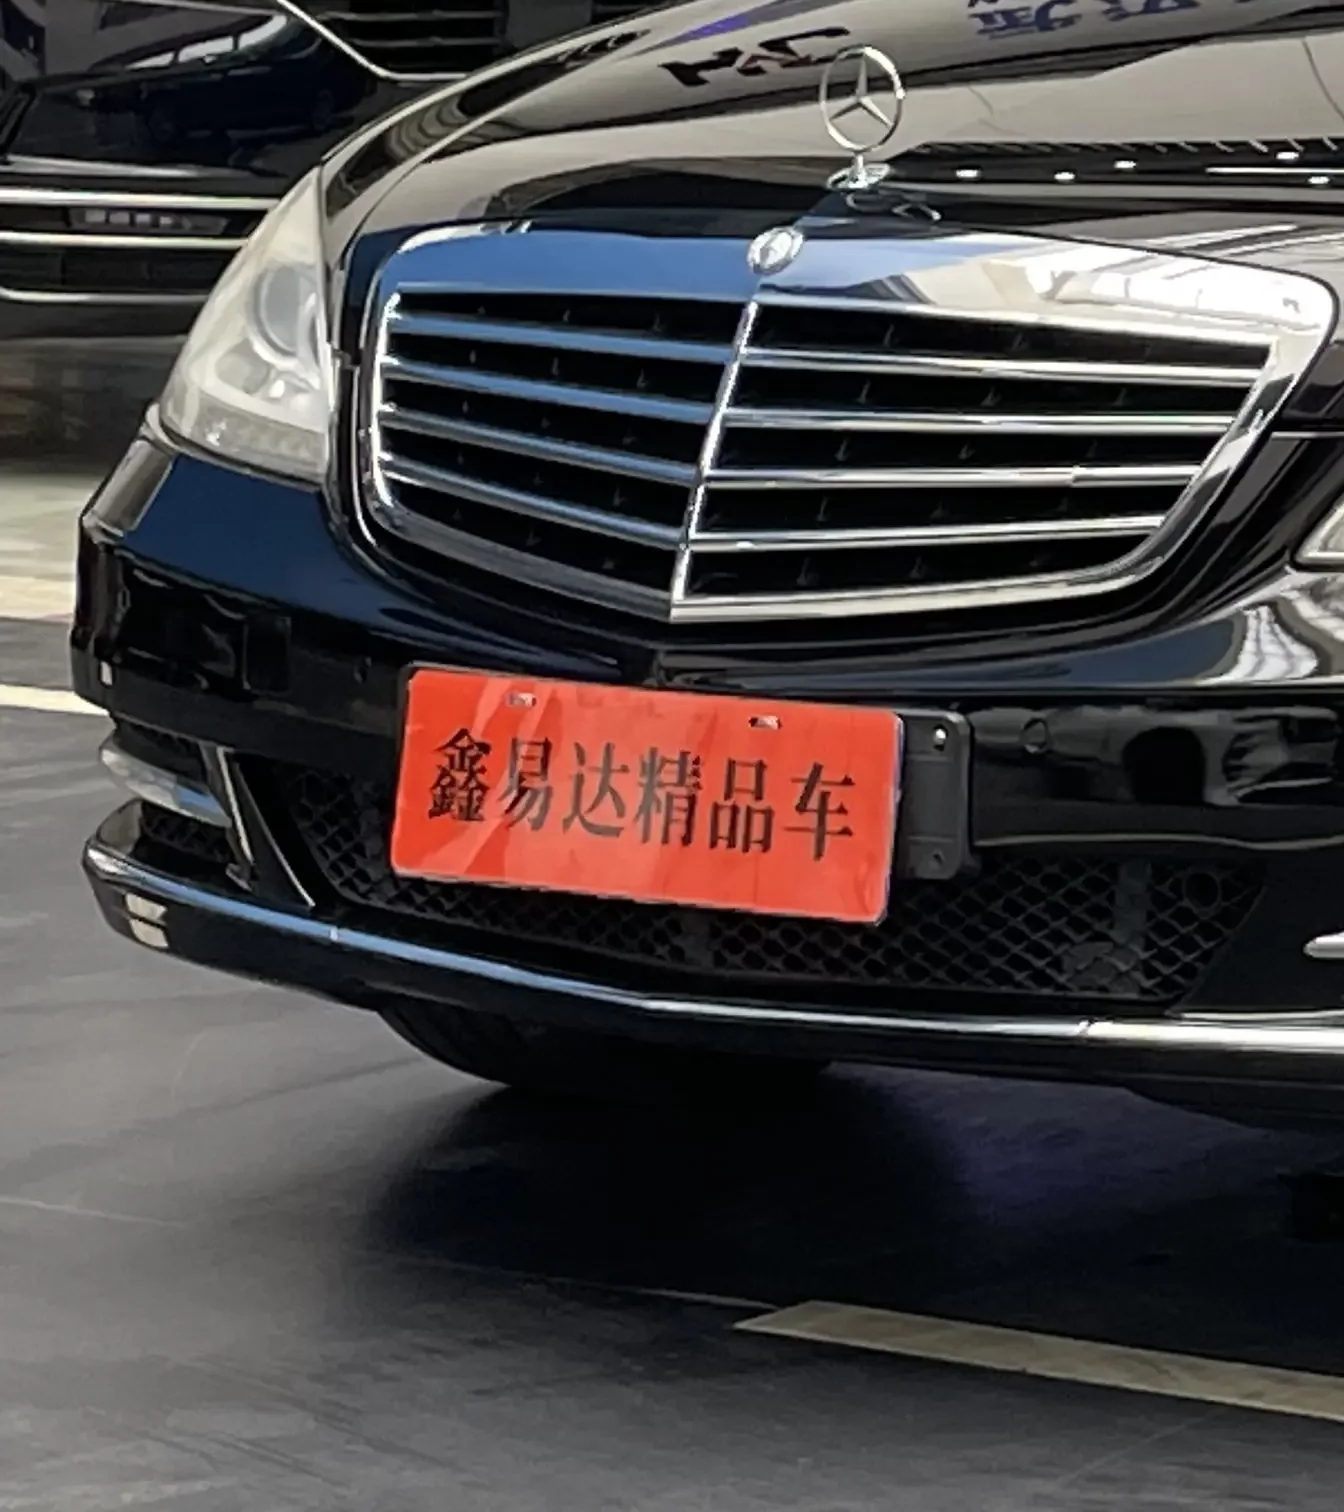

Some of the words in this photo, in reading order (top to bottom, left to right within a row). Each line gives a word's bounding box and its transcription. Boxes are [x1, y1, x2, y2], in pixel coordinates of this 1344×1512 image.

[427, 727, 856, 862] 鑫易达精品车
